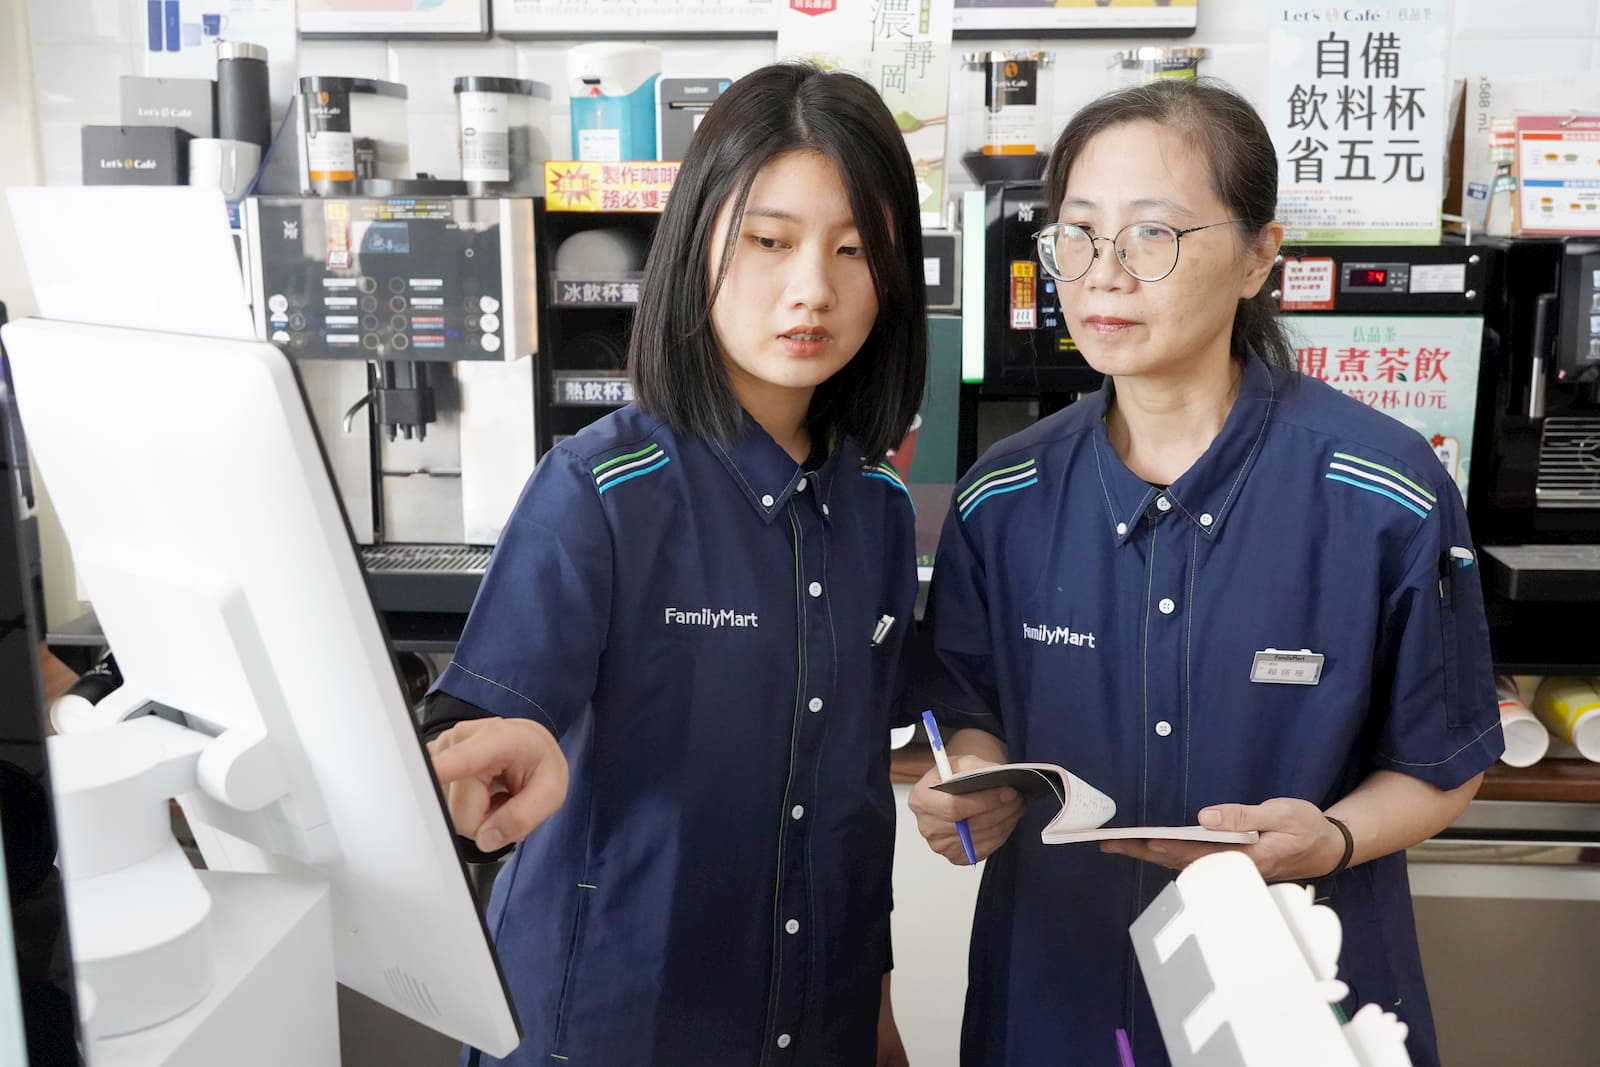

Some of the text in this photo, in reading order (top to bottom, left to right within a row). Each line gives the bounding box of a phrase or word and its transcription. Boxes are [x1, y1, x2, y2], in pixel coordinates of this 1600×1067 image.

[1283, 9, 1381, 22] Let's Café
[1316, 31, 1400, 79] 自備
[1287, 83, 1426, 131] 飲料杯
[100, 158, 157, 169] Let's Café
[1286, 136, 1425, 185] 省五元
[1367, 271, 1385, 283] 34
[563, 282, 640, 303] 冰飲杯蓋
[1297, 346, 1451, 384] 現煮茶飲
[664, 607, 759, 629] FamilyMart
